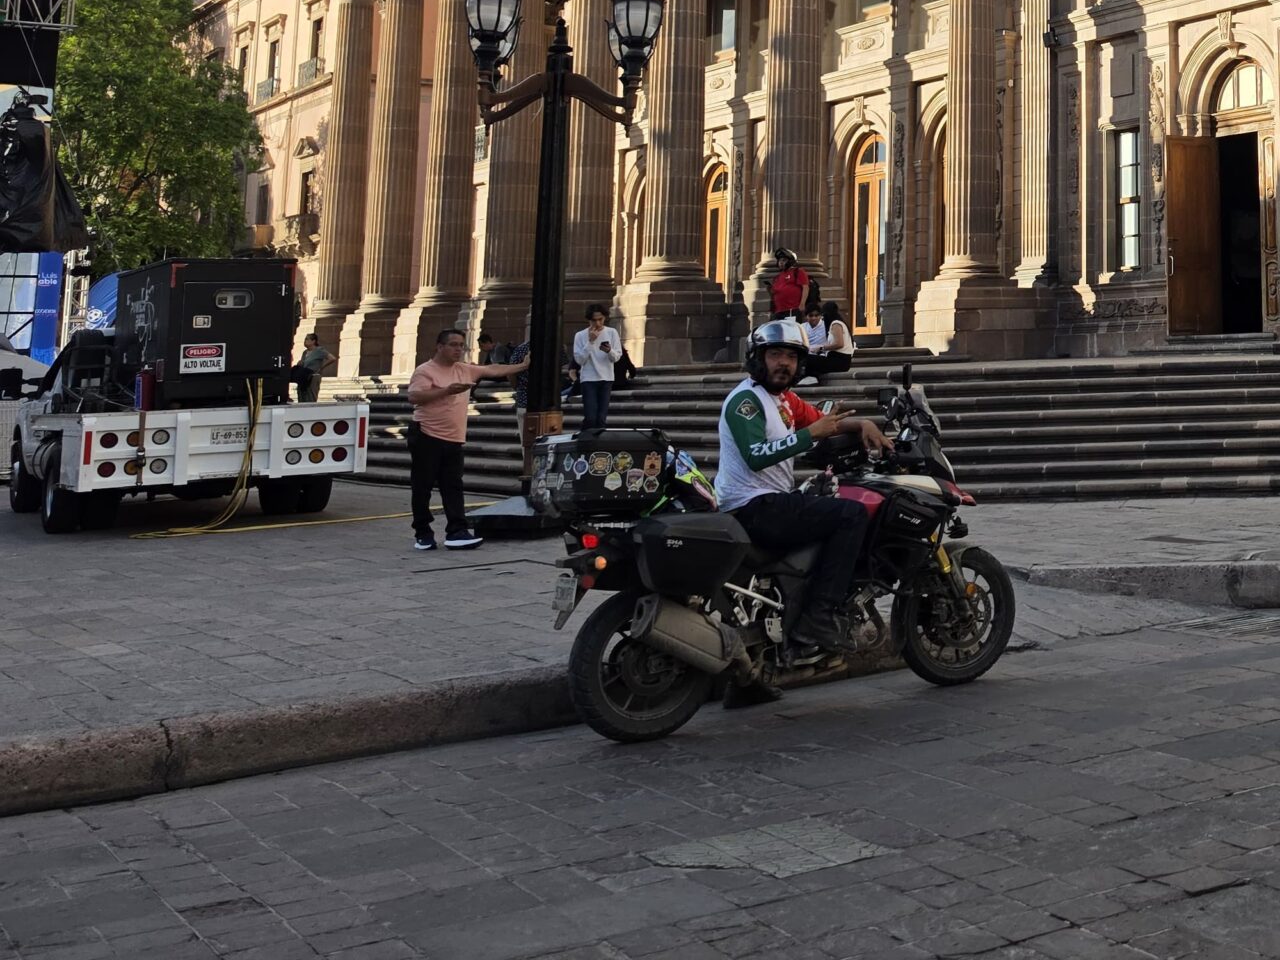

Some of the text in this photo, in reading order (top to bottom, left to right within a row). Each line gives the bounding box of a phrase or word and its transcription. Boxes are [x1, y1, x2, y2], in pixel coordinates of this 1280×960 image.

[189, 347, 218, 356] PELIGRO
[183, 360, 199, 369] ALTO
[199, 359, 223, 369] VOLTAJE
